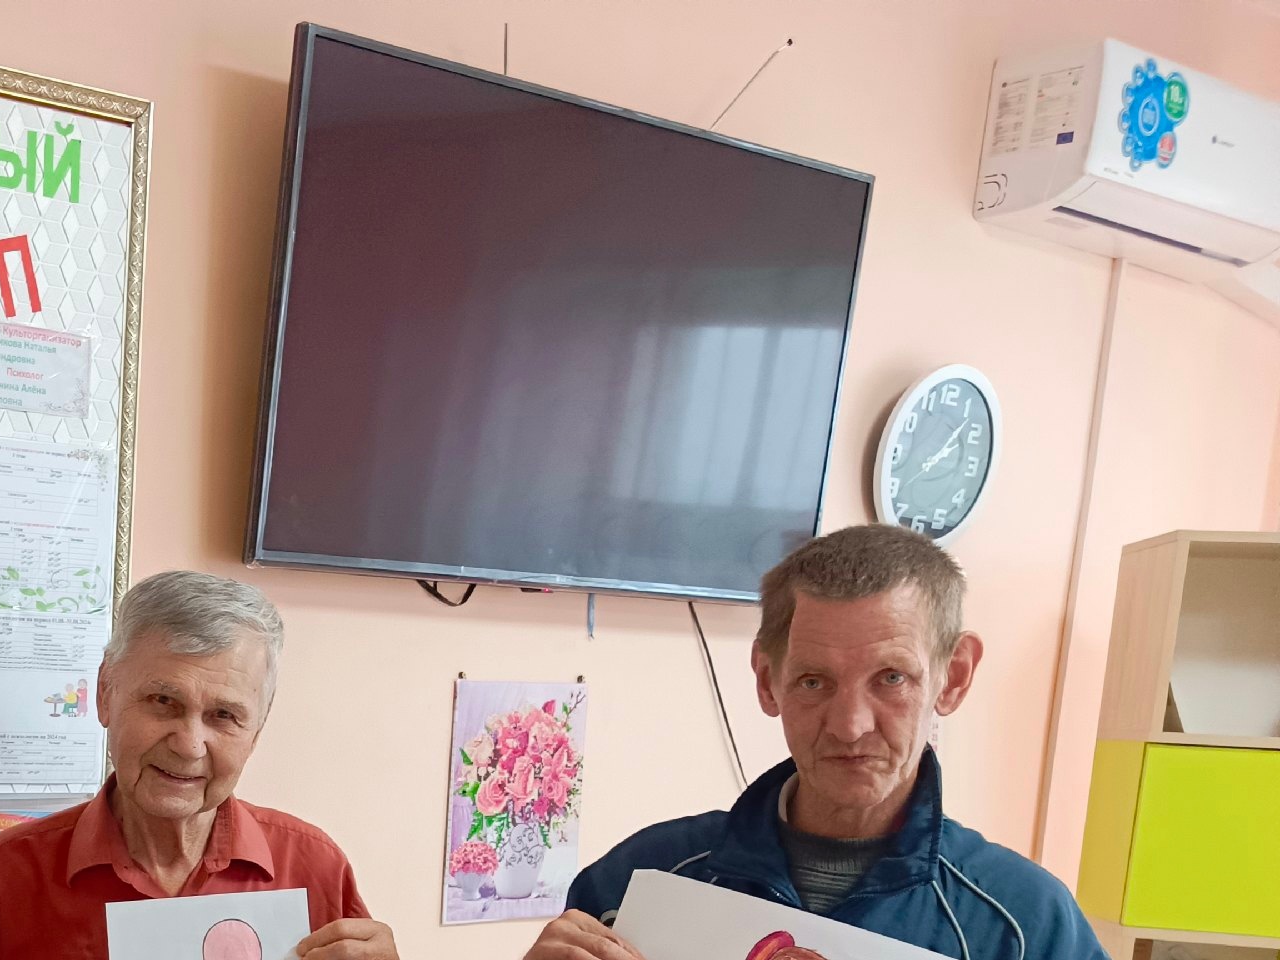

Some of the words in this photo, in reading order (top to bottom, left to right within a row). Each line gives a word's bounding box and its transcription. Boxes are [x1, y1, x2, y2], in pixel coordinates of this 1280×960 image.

[940, 383, 961, 406] 12
[963, 398, 972, 418] 1
[967, 423, 983, 445] 2
[964, 456, 980, 478] 3
[951, 488, 967, 508] 4
[931, 508, 948, 530] 5
